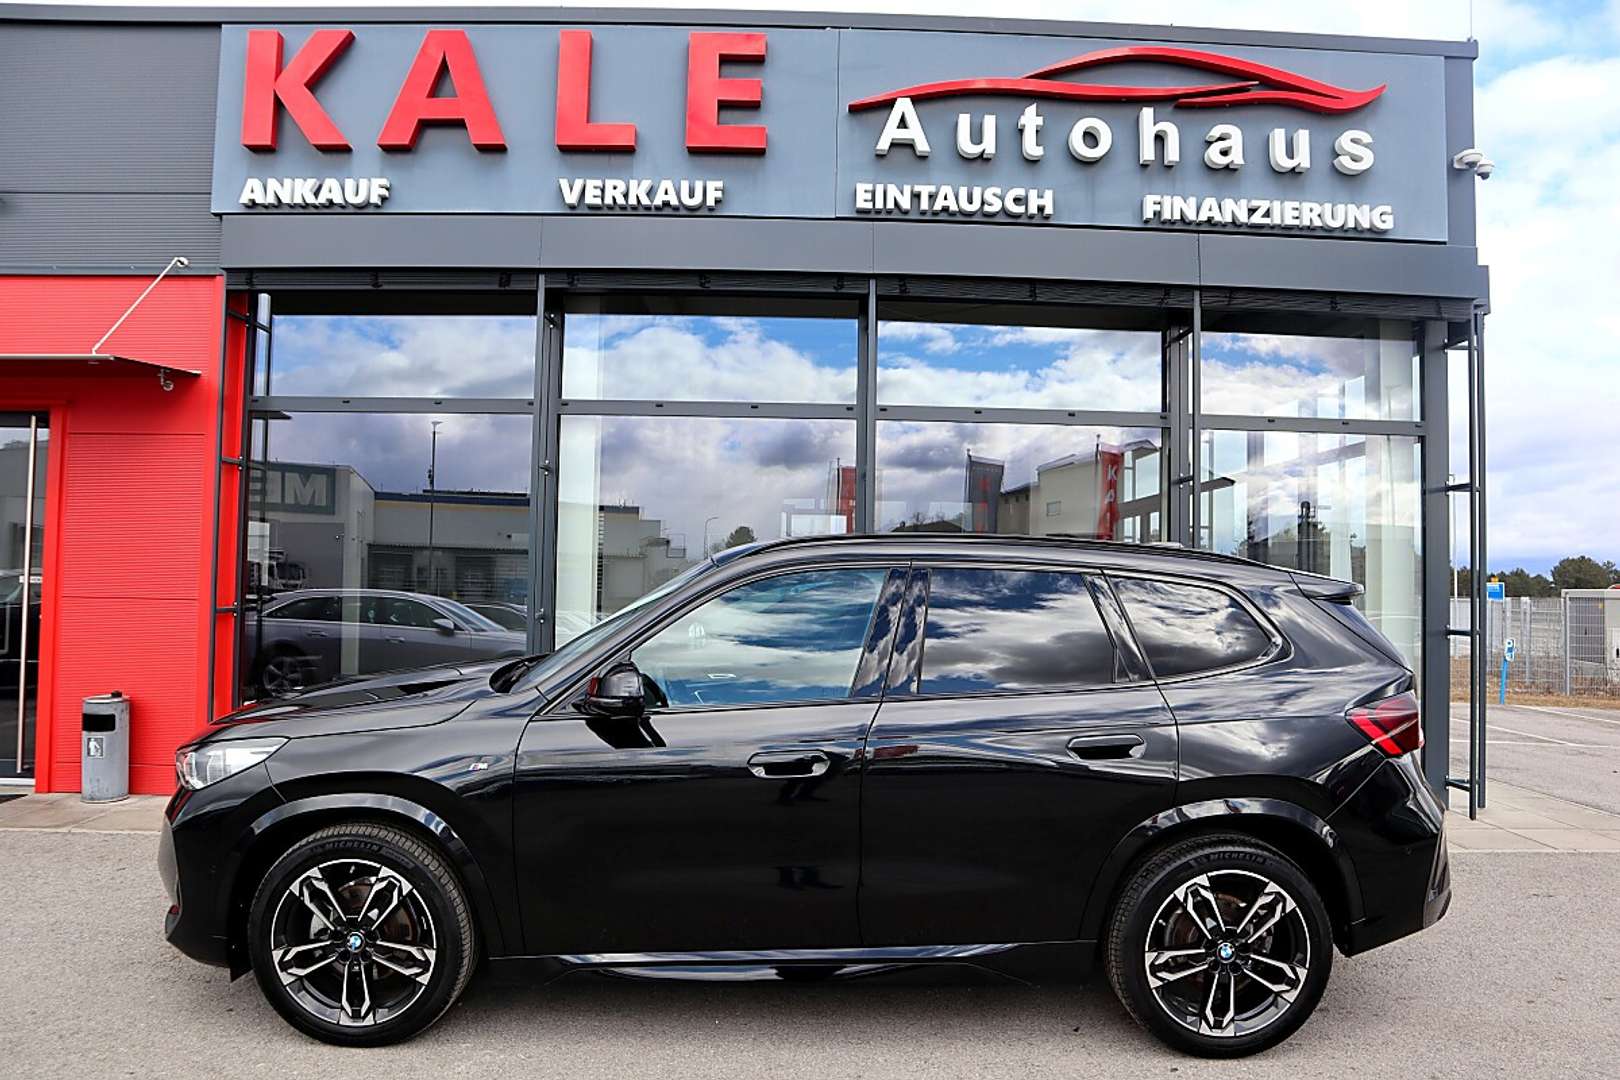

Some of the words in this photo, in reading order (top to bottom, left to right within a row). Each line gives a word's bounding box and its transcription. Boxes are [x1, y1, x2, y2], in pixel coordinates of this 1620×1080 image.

[241, 29, 768, 154] KALE
[875, 97, 1376, 175] Autohaus
[239, 178, 391, 208] ANKAUF
[559, 178, 725, 209] VERKAUF
[855, 182, 1055, 217] EINTAUSCH
[1142, 194, 1395, 231] FINANZIERUNG
